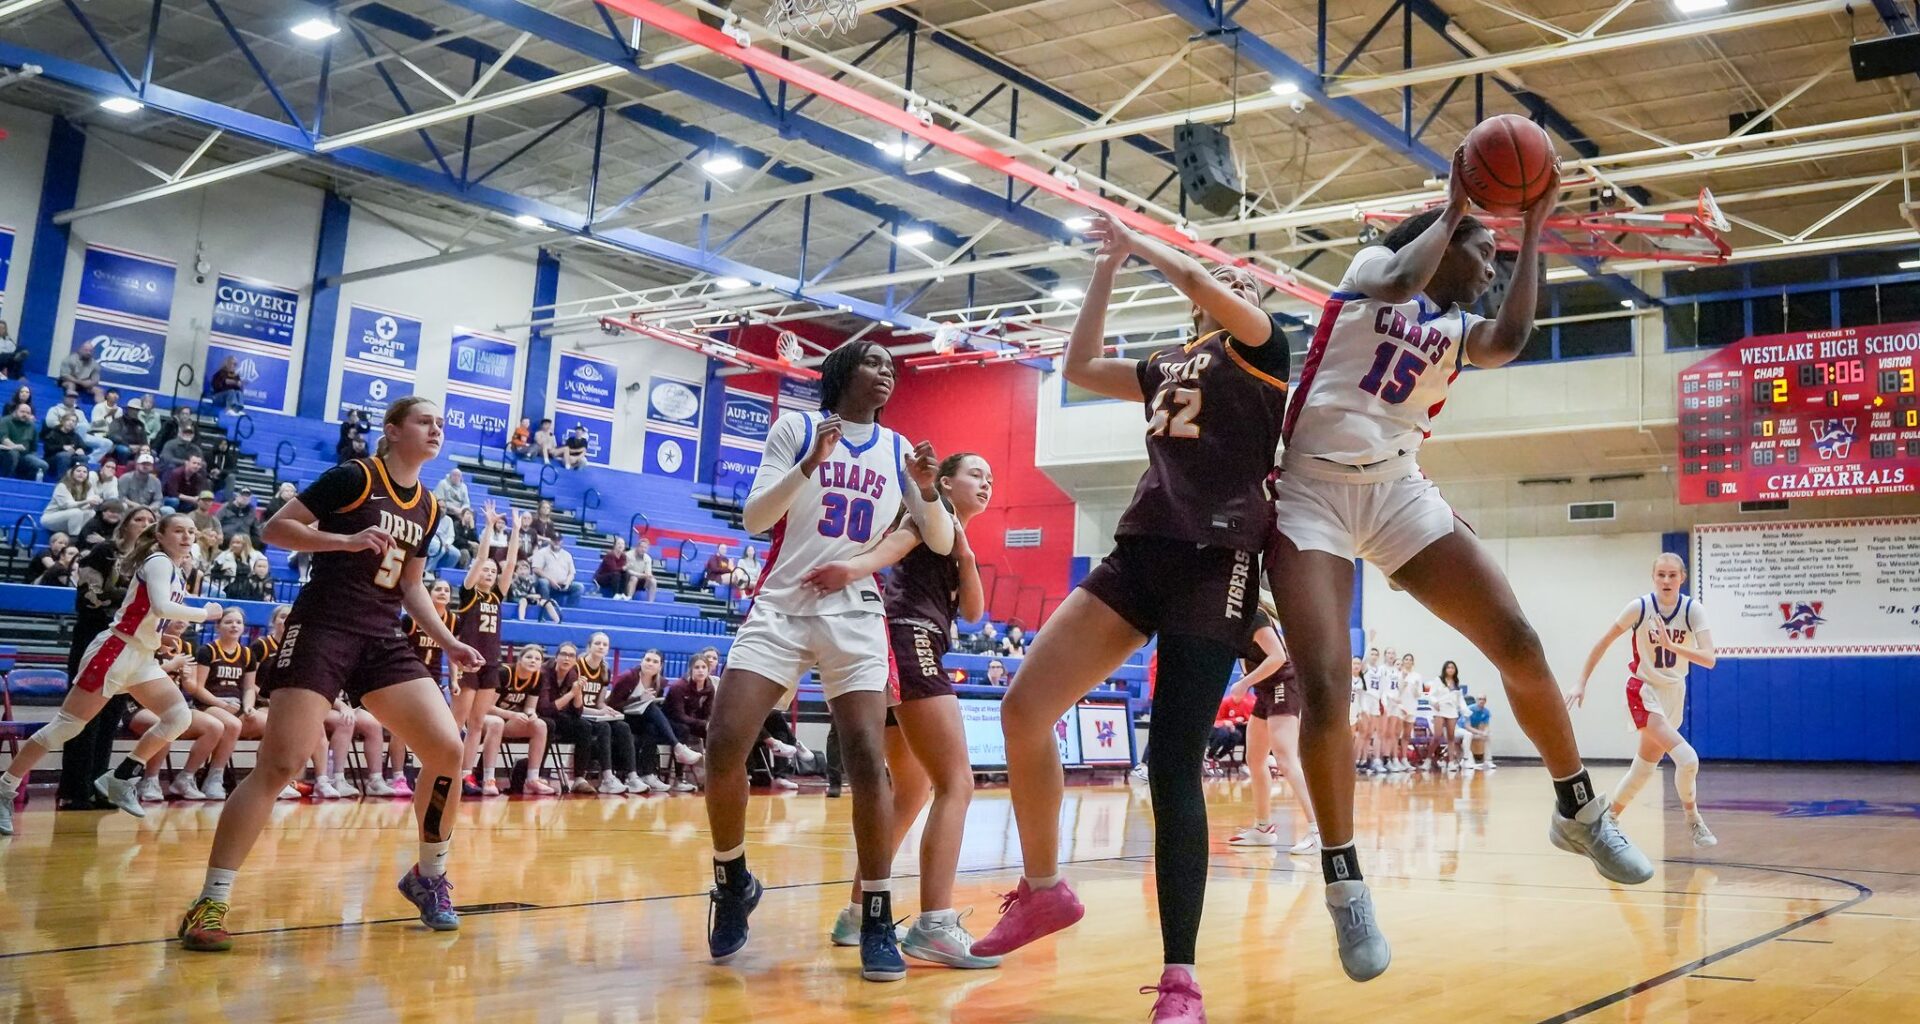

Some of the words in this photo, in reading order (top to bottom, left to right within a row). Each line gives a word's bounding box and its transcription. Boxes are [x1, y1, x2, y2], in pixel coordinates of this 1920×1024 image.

[218, 286, 297, 314] COVERT
[216, 302, 250, 314] AUTO
[255, 309, 293, 323] GROUP
[363, 335, 405, 351] COMPLETE
[1374, 306, 1451, 364] CHAPS
[1806, 330, 1844, 339] WELCOME
[89, 335, 153, 362] Cane's
[371, 345, 395, 358] CARE
[1740, 344, 1814, 365] WESTLAKE
[1820, 338, 1859, 358] HIGH
[1358, 341, 1428, 404] 15
[1754, 367, 1785, 379] CHAPS
[1879, 357, 1912, 368] VISITOR
[1773, 379, 1788, 403] 2
[1899, 369, 1915, 392] 3
[469, 414, 506, 429] AUSTIN
[1751, 441, 1776, 450] PLAYER
[1780, 438, 1801, 447] FOULS
[1870, 433, 1896, 441] PLAYER
[1767, 468, 1905, 490] CHAPARRALS
[1808, 465, 1832, 473] HOME
[819, 461, 887, 500] CHAPS
[1782, 490, 1815, 498] PROUDLY
[1817, 488, 1853, 497] SUPPORTS
[1855, 487, 1872, 495] WHS
[1875, 485, 1915, 494] ATHLETICS
[379, 509, 423, 548] DRIP
[817, 491, 875, 544] 30
[374, 549, 406, 589] 5
[1225, 549, 1250, 620] TIGERS
[478, 614, 498, 633] 25
[277, 624, 302, 668] IGERS
[1654, 645, 1677, 668] 10
[217, 666, 243, 679] DRIP
